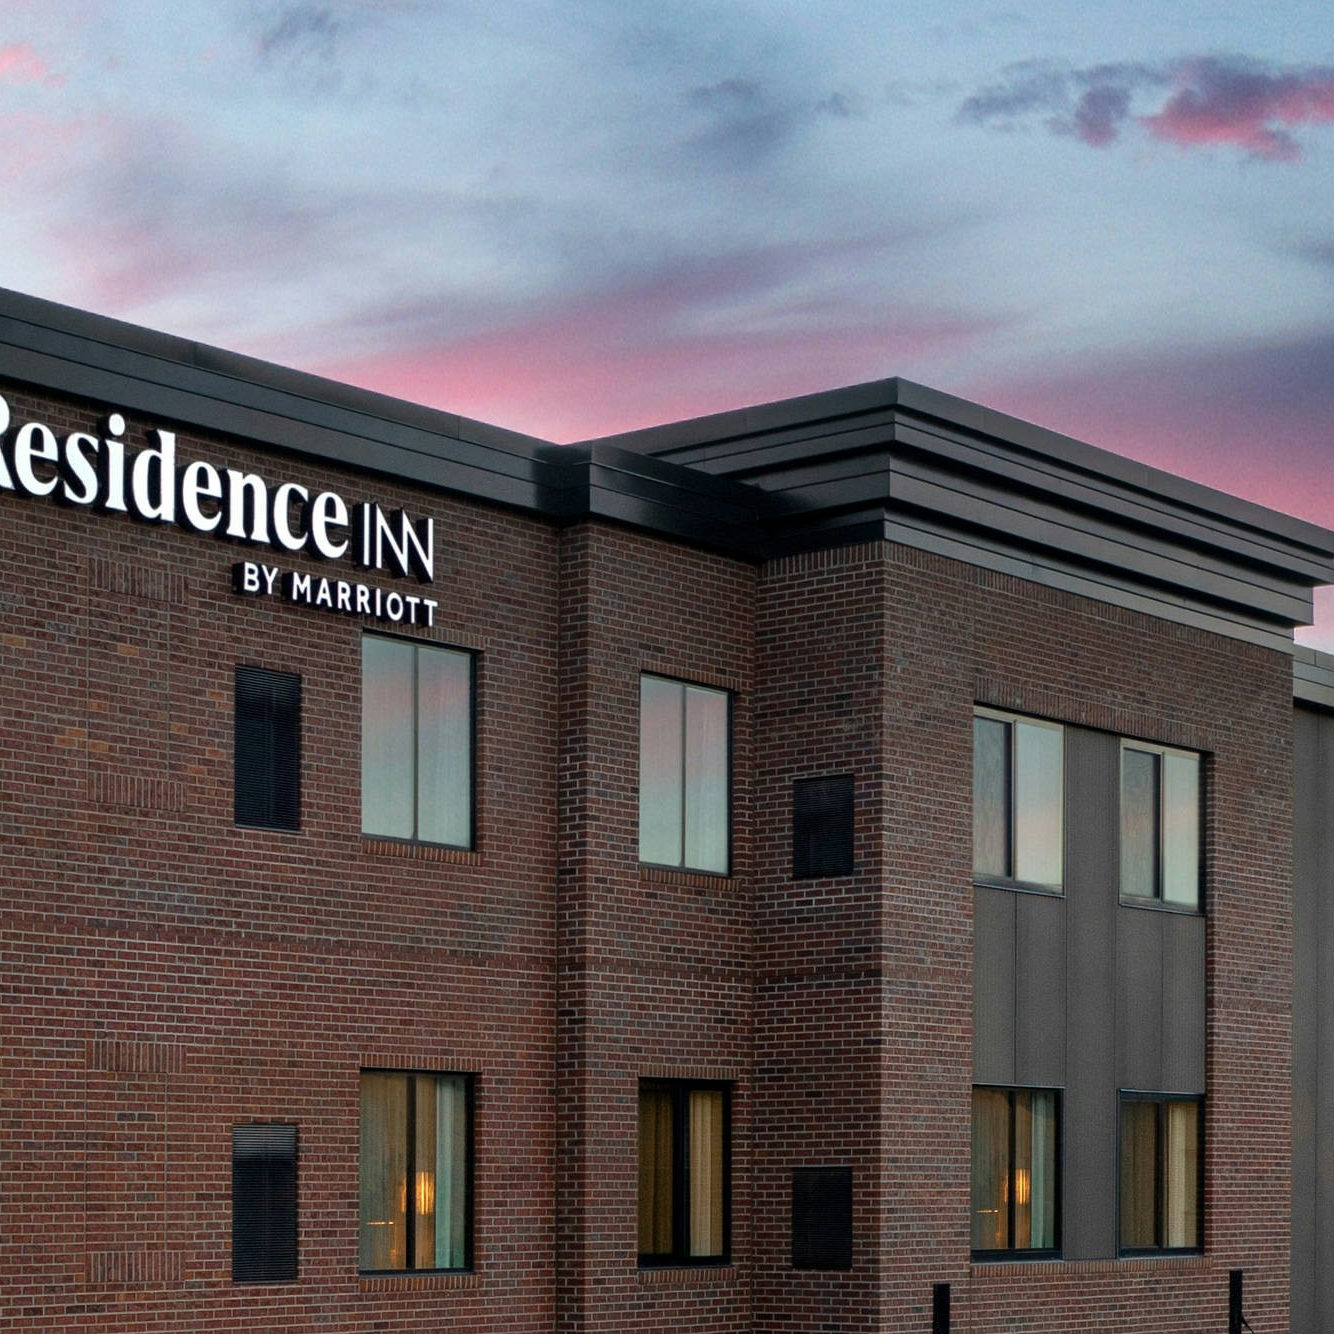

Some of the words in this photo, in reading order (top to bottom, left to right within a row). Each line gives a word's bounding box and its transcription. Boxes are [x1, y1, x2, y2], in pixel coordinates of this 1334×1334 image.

[362, 501, 434, 583] INN
[243, 561, 279, 595] BY
[292, 571, 439, 627] MARRIOTT
